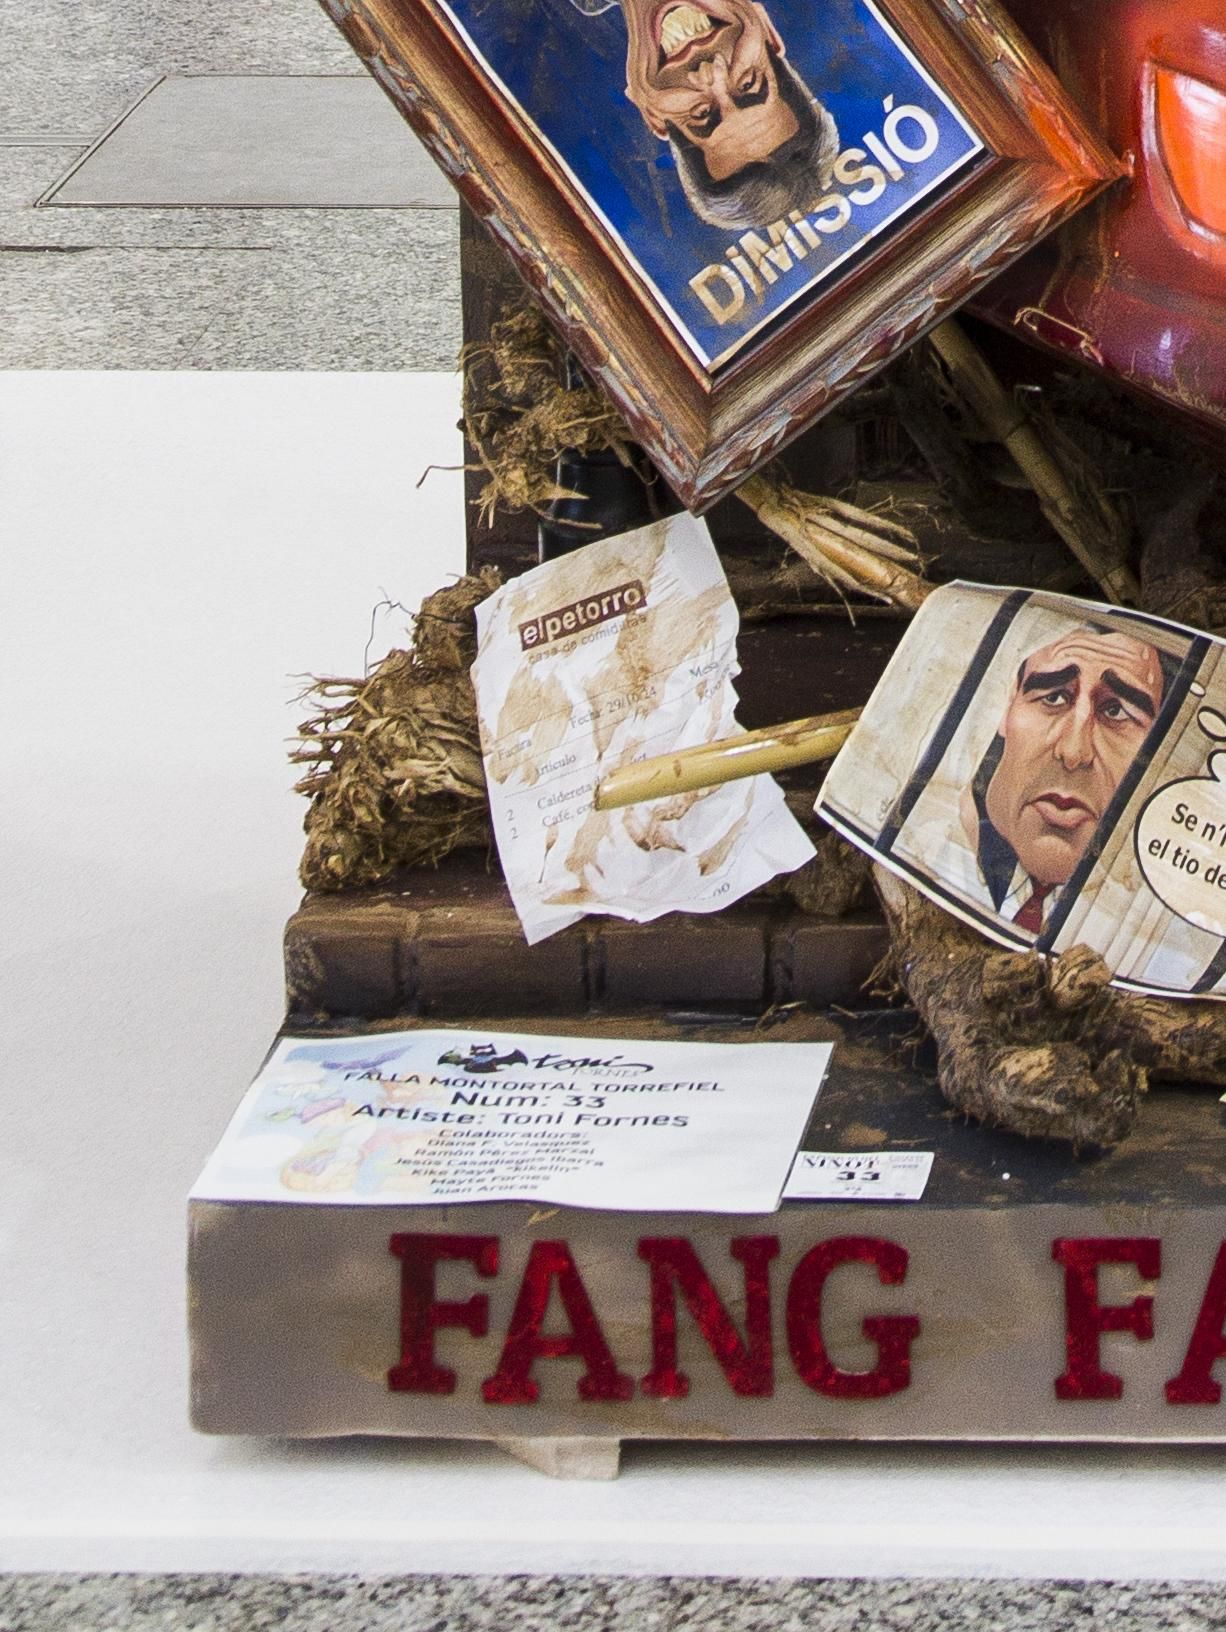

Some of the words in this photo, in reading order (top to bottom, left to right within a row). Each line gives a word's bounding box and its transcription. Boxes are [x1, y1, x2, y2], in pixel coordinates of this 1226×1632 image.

[1171, 802, 1198, 832] Se
[1148, 838, 1170, 860] el
[1171, 846, 1199, 875] tio
[344, 1071, 421, 1085] FALLA
[429, 1075, 580, 1092] MONTORTAL
[592, 1081, 725, 1093] TORREFIEL
[450, 1091, 552, 1108] Num:
[563, 1095, 607, 1109] 33
[352, 1103, 486, 1125] Artiste:
[500, 1111, 563, 1125] Toni
[574, 1113, 689, 1127] Fornes
[387, 1232, 921, 1404] FANG
